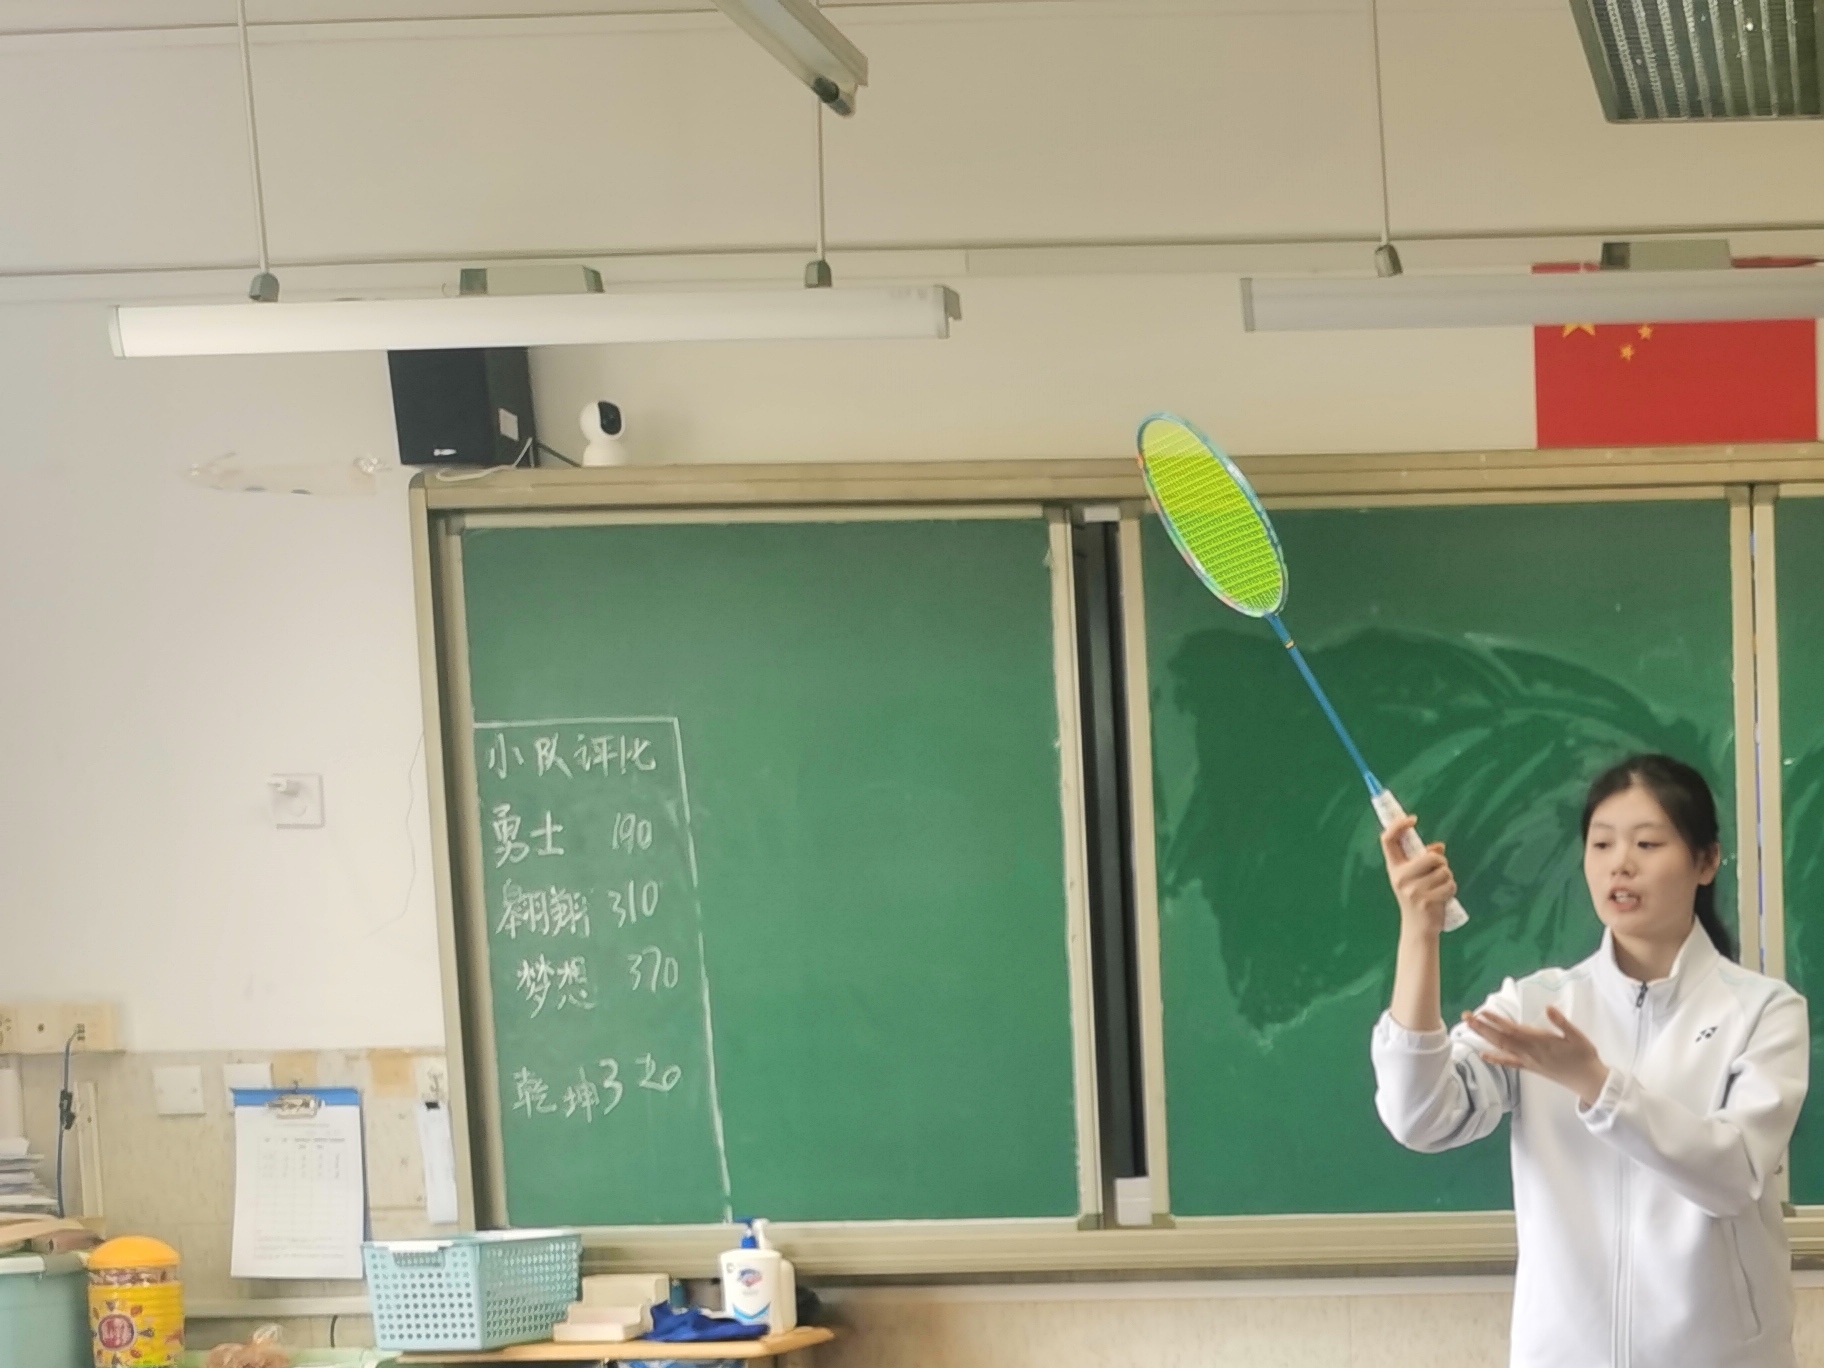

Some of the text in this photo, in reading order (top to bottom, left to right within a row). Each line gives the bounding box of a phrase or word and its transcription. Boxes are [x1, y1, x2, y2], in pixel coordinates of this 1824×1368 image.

[488, 731, 657, 780] 小队评比
[492, 803, 653, 869] 勇士 190
[495, 878, 659, 939] 翱翔 310
[516, 945, 678, 1018] 梦想 370
[511, 1053, 682, 1123] 乾坤 320
